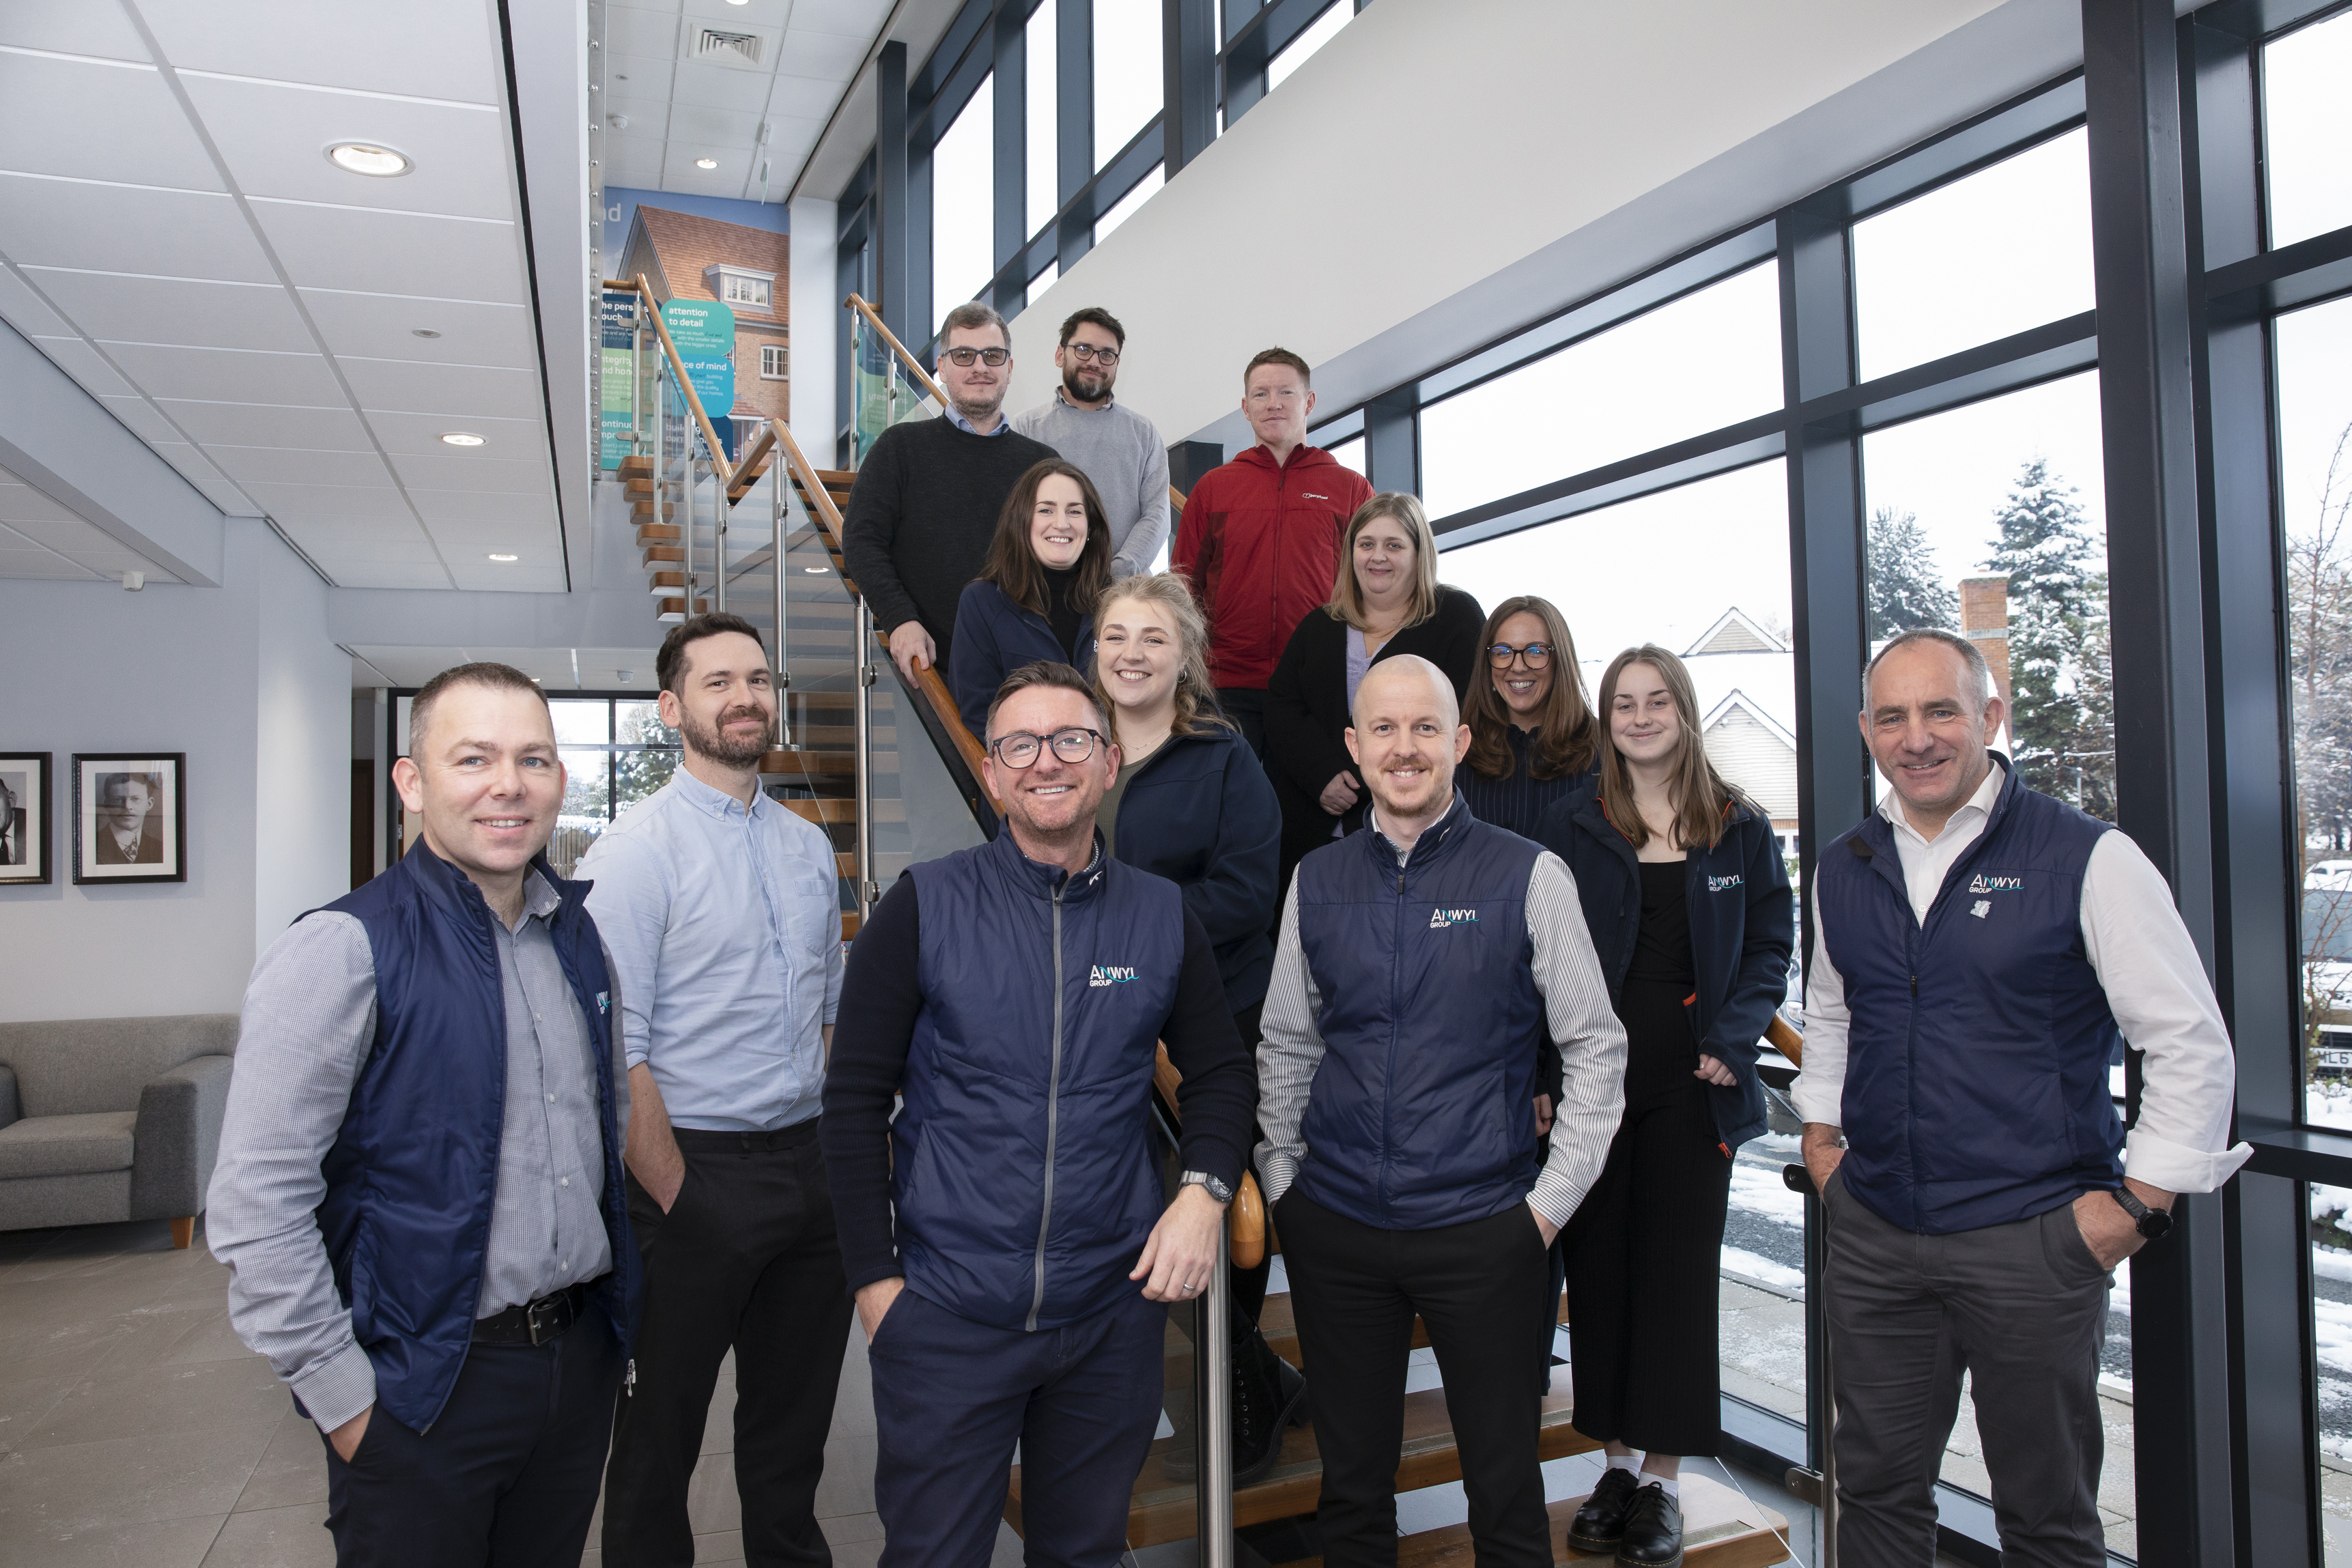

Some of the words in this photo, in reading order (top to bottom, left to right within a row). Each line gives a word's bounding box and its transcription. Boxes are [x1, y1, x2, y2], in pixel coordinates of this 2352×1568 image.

[604, 203, 621, 222] d
[601, 301, 612, 309] he
[668, 307, 708, 317] attention
[679, 318, 703, 327] detail
[601, 356, 633, 366] ntegrity
[696, 361, 705, 369] of
[706, 362, 727, 371] mind
[1708, 874, 1744, 889] ANWYL
[1970, 874, 2024, 891] ANWYL
[1430, 908, 1479, 923] ANWYL
[1090, 965, 1139, 982] ANWYL
[1089, 979, 1113, 987] GROUP
